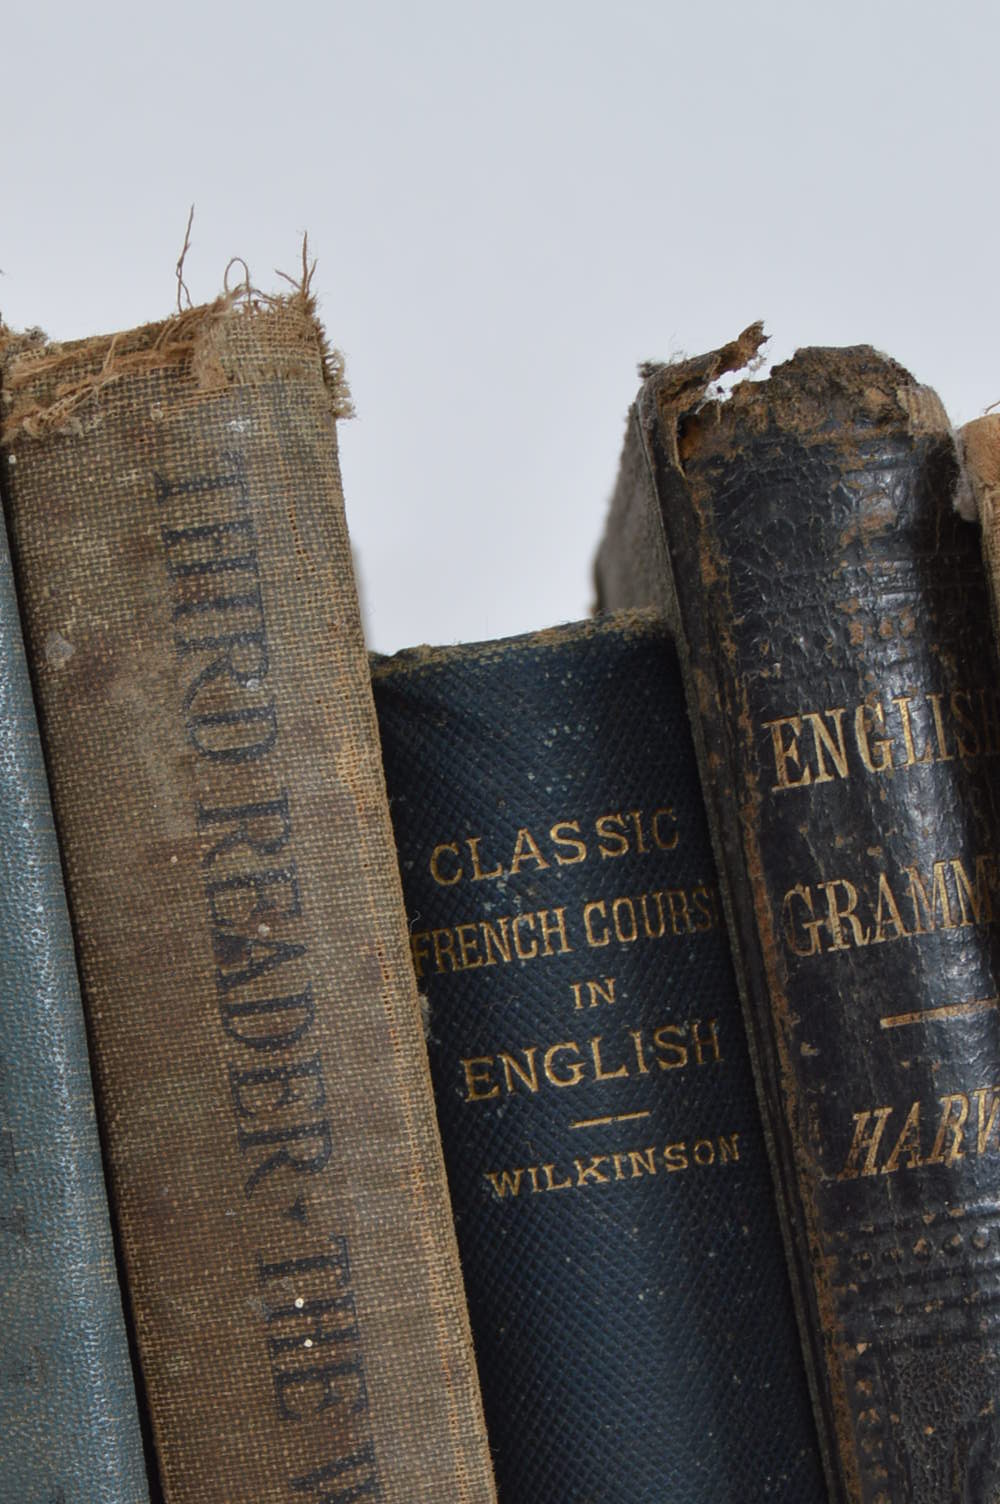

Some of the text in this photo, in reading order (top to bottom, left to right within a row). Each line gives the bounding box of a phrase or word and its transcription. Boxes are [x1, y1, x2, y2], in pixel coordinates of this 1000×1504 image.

[150, 460, 282, 763] THIRD
[429, 807, 680, 886] CLASSIC
[412, 886, 722, 977] FRENCH COURS
[195, 790, 336, 1191] READER
[571, 978, 617, 1011] IN
[460, 1018, 723, 1103] ENGLISH
[484, 1133, 743, 1199] WILKINSON
[256, 1236, 369, 1423] THE
